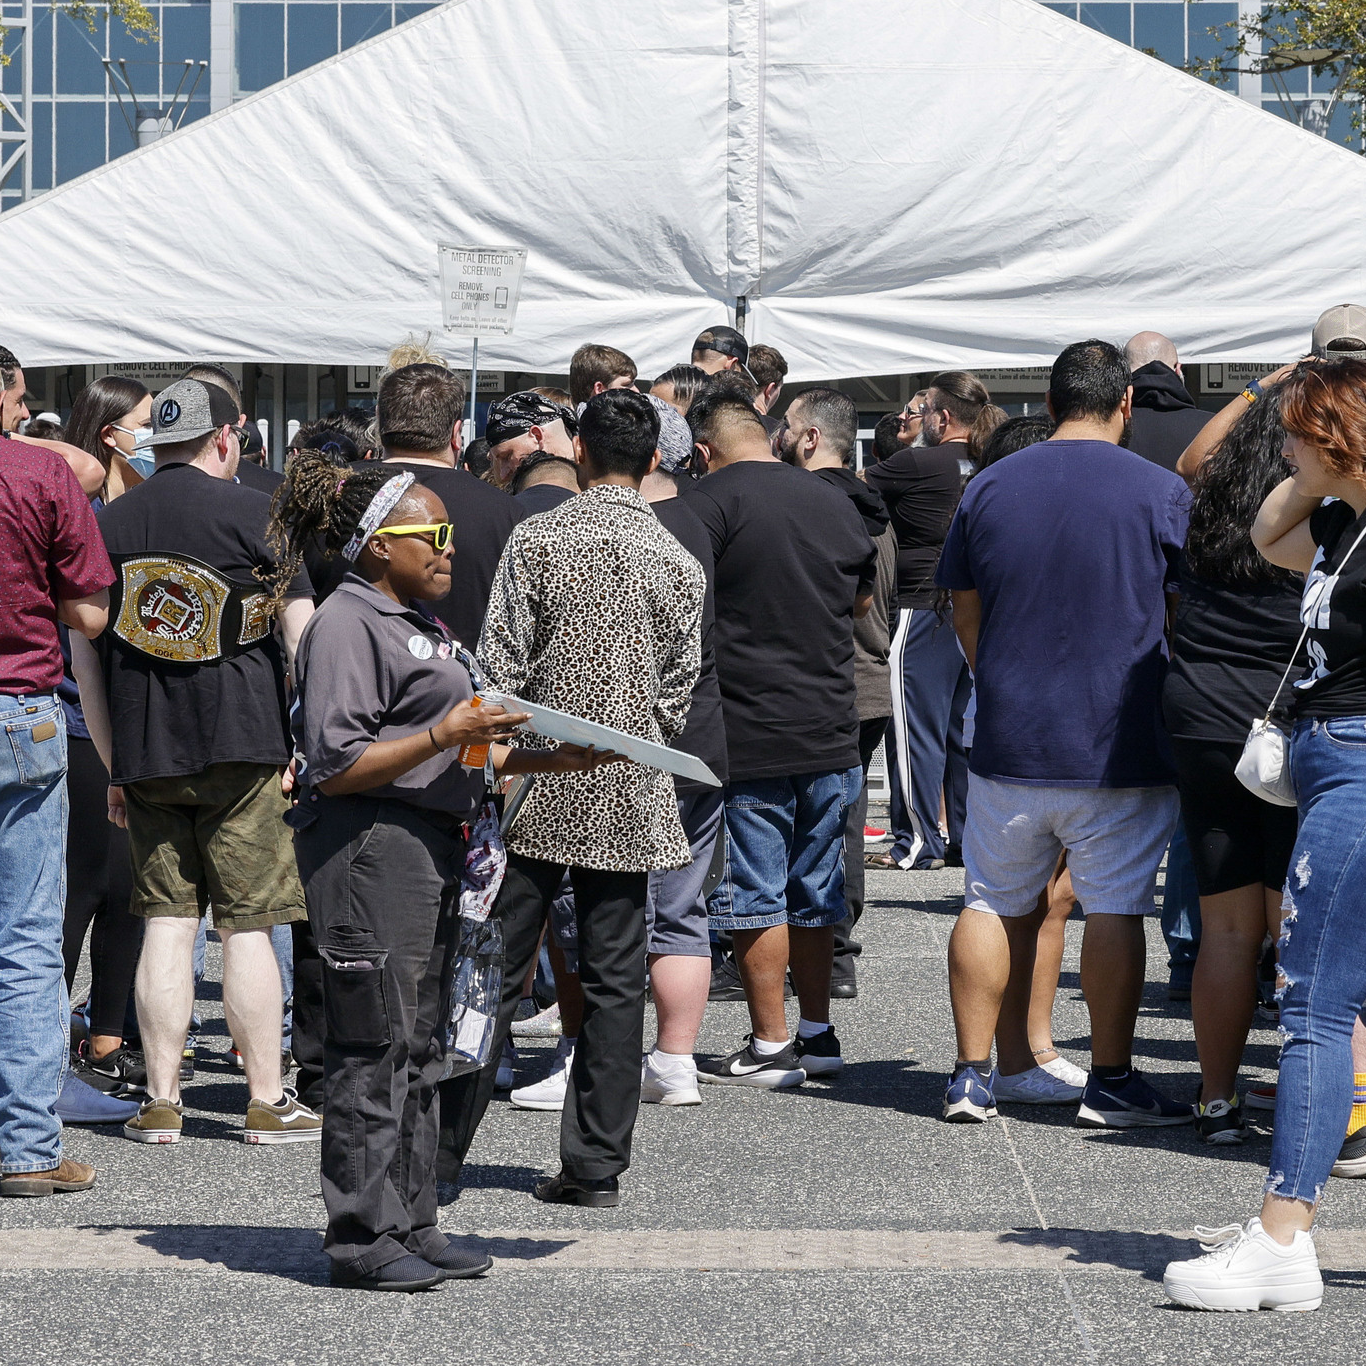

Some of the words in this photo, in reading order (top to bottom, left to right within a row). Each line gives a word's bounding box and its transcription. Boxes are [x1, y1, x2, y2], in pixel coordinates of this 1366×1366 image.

[451, 252, 476, 263] METAL
[478, 254, 514, 265] DETECTOR
[462, 265, 502, 277] SCREENING
[458, 281, 484, 291] REMOVE
[451, 291, 464, 300] CELL
[466, 292, 490, 302] PHONES
[461, 302, 478, 310] ONLY
[113, 362, 147, 371] REMOVE
[149, 362, 167, 371] CELL
[1228, 363, 1265, 372] REMOVE
[154, 648, 175, 659] EDGE
